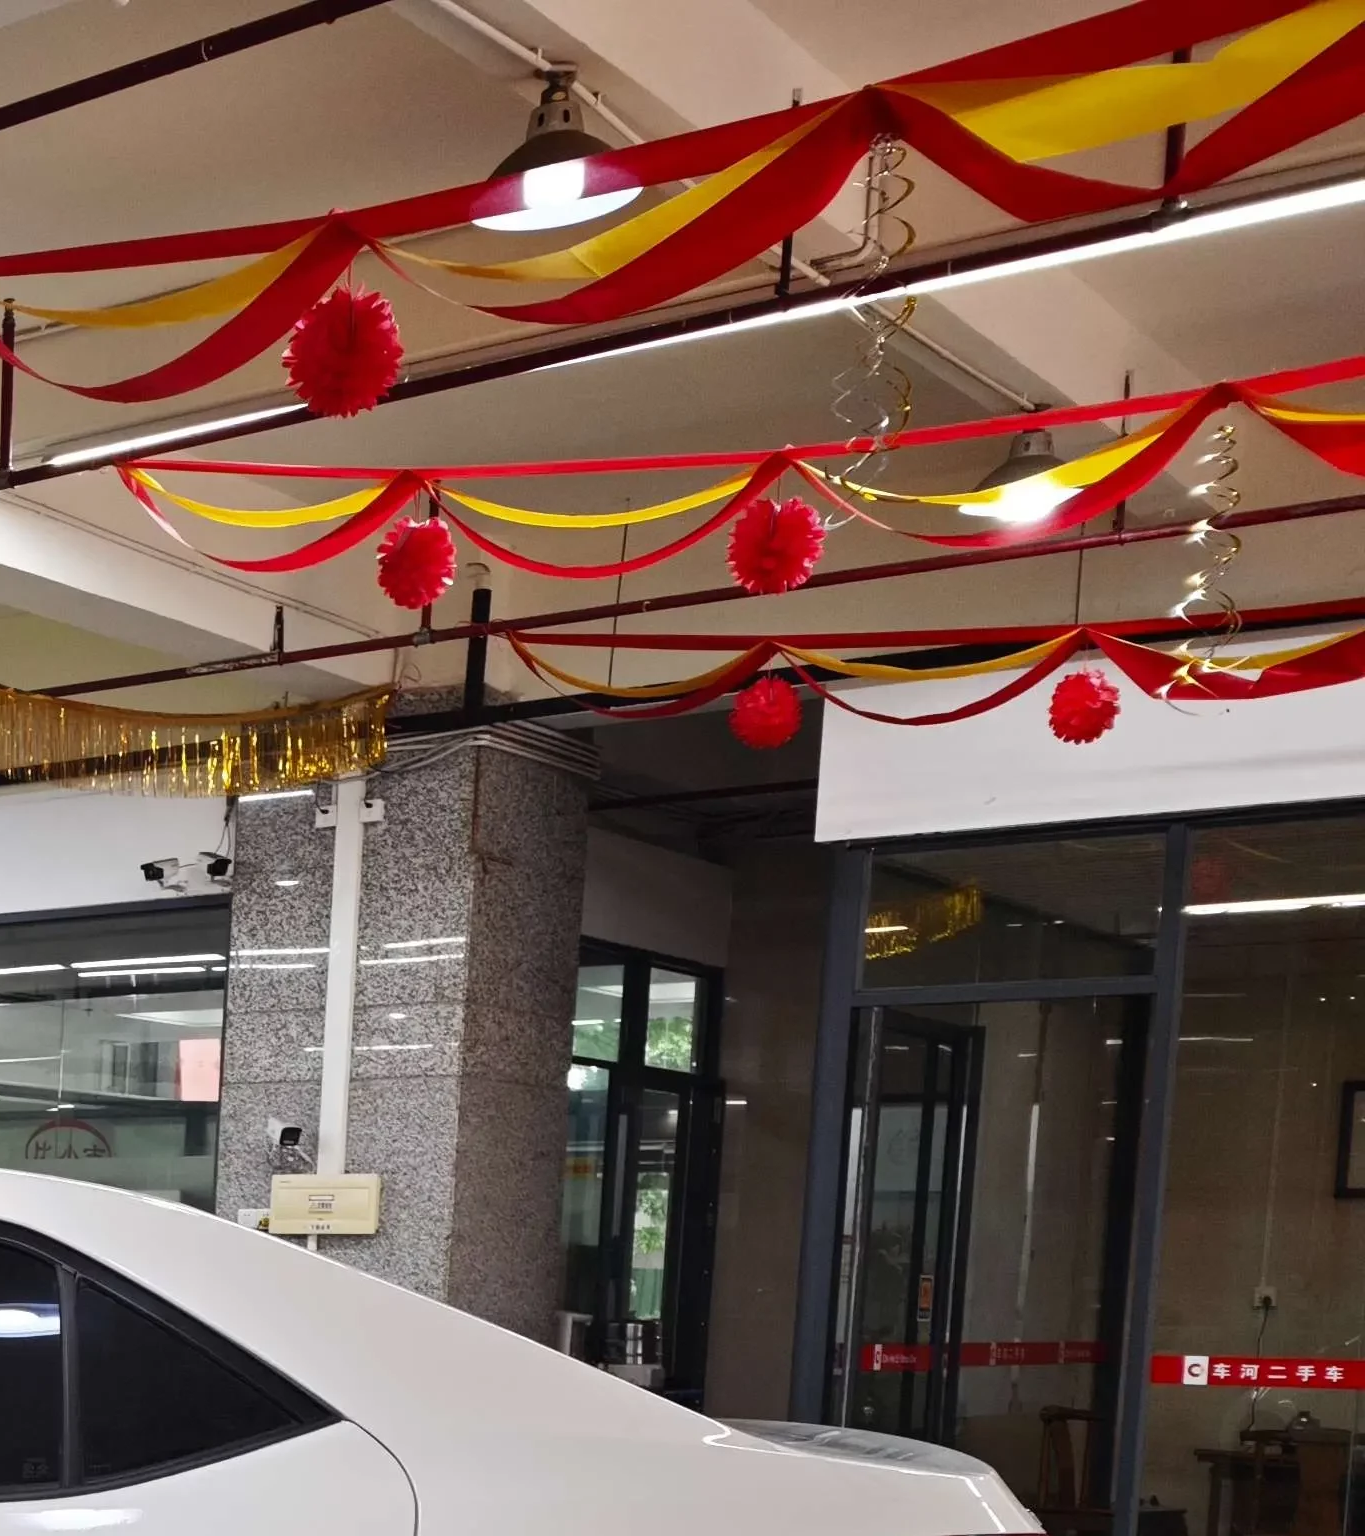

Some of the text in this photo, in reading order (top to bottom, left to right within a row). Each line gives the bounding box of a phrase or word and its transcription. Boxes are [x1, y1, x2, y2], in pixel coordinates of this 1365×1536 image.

[1212, 1362, 1345, 1382] 车河二手车
